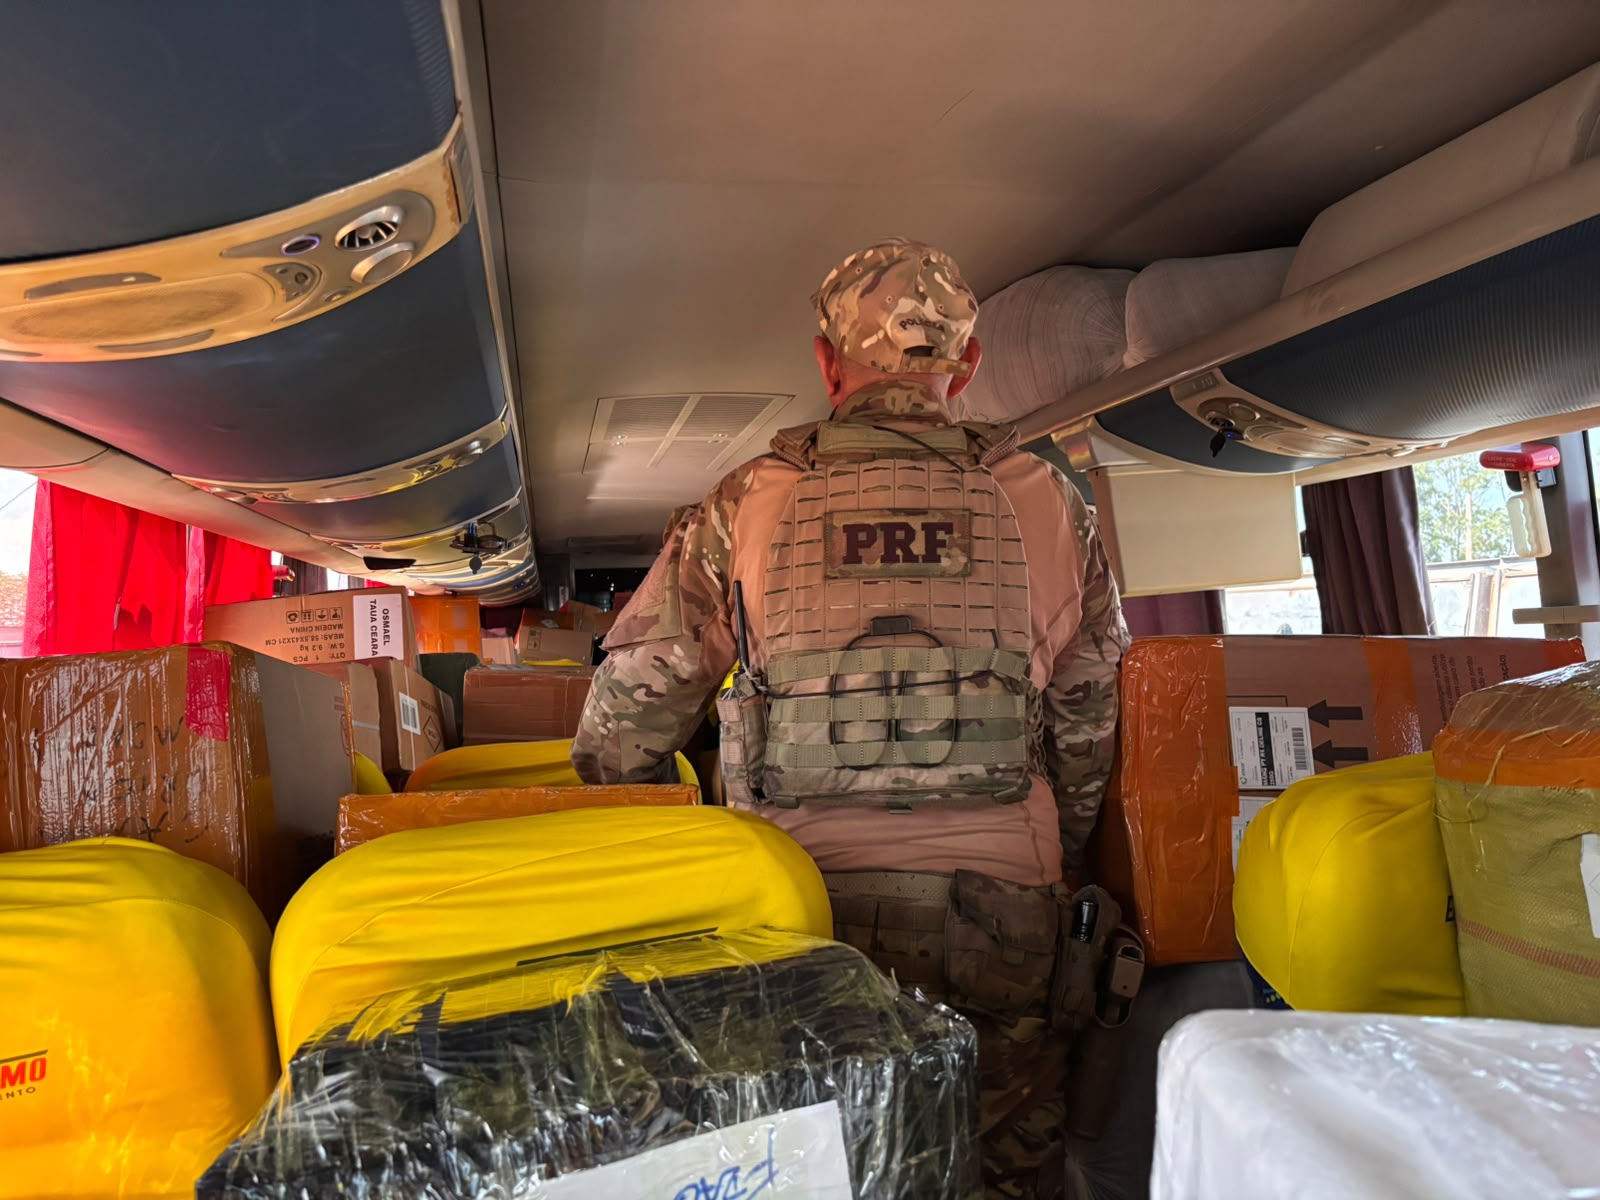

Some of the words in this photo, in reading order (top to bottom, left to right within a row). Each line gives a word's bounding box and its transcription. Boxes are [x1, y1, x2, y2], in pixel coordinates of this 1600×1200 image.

[843, 522, 953, 564] PRF
[369, 599, 377, 623] TAUA
[265, 638, 277, 646] CM
[370, 625, 379, 656] CEARA
[382, 608, 391, 646] OSMAEL
